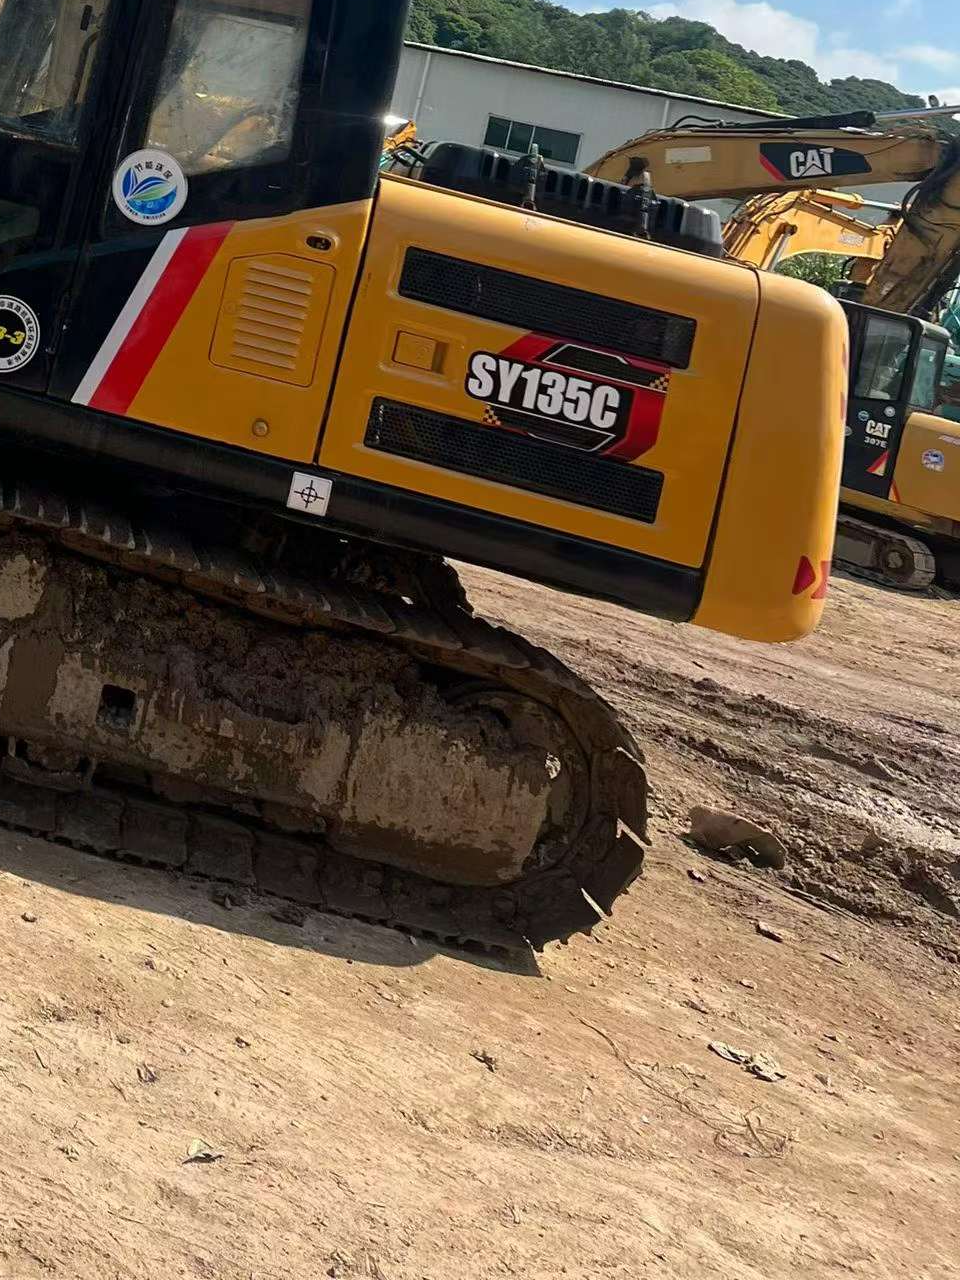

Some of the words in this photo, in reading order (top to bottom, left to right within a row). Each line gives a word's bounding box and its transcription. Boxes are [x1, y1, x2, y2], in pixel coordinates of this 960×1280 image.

[790, 147, 835, 178] CAT
[468, 354, 620, 428] SY135C
[865, 420, 892, 438] CAT
